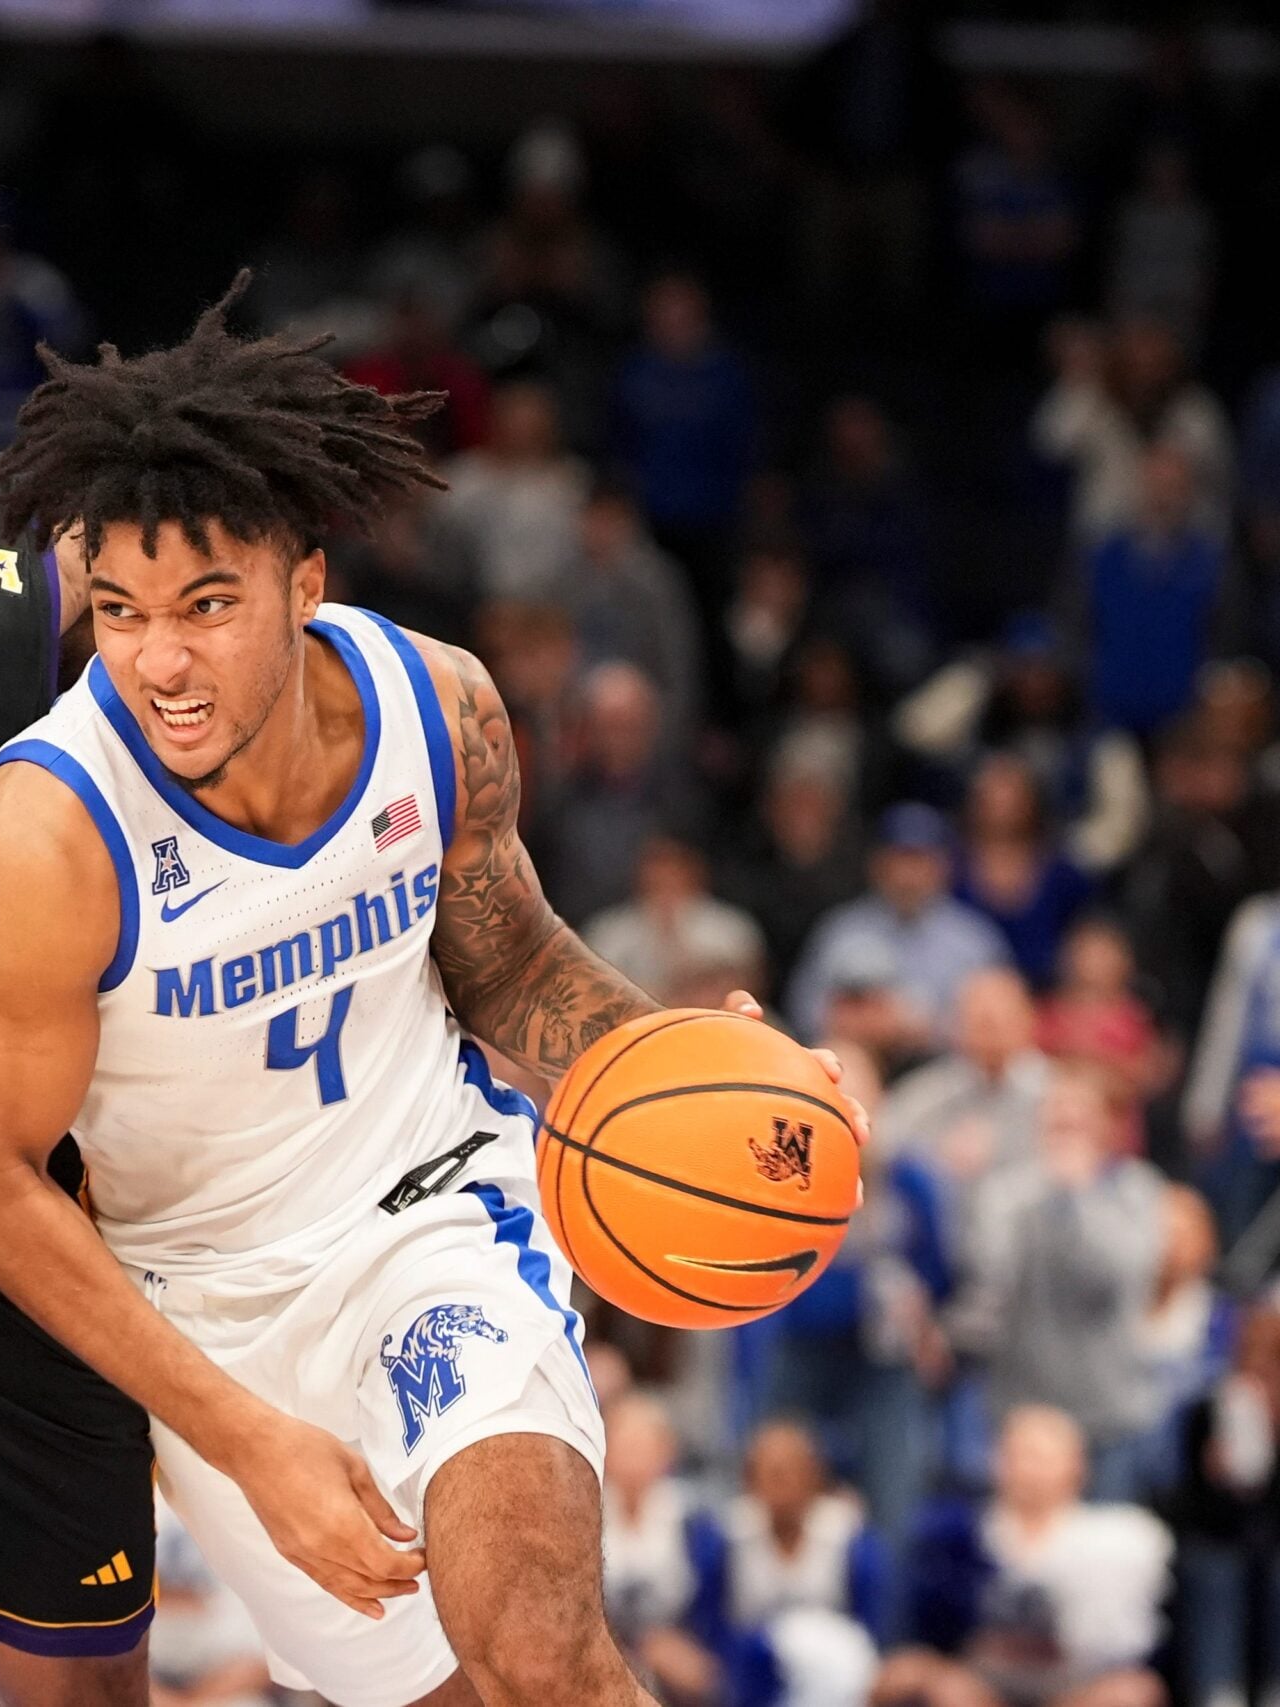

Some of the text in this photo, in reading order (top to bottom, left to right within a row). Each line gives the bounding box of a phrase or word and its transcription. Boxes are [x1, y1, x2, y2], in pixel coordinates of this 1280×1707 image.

[151, 835, 190, 895] A
[148, 863, 438, 1019] Memphis
[264, 980, 358, 1109] 4
[387, 1356, 466, 1457] M
